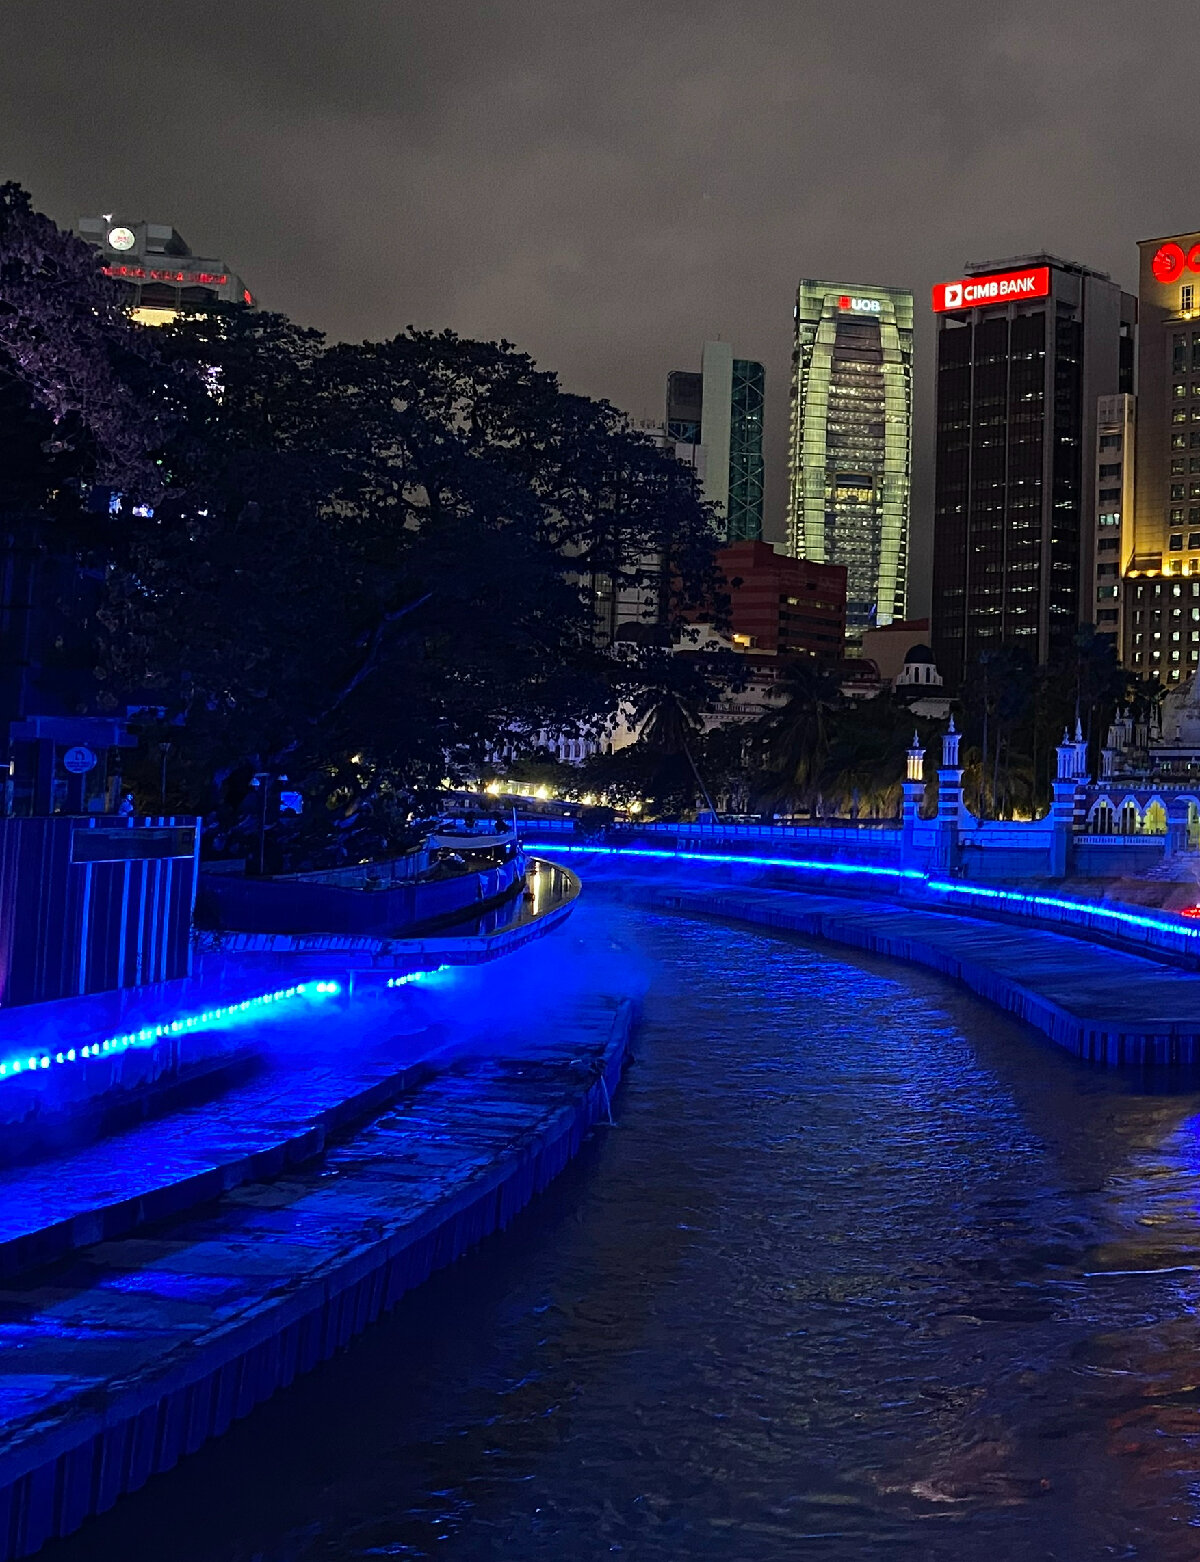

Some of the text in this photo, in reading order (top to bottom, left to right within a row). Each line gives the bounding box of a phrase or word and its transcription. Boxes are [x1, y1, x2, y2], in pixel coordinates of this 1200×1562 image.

[964, 276, 1036, 301] CIMB BANK
[851, 298, 880, 311] UOB
